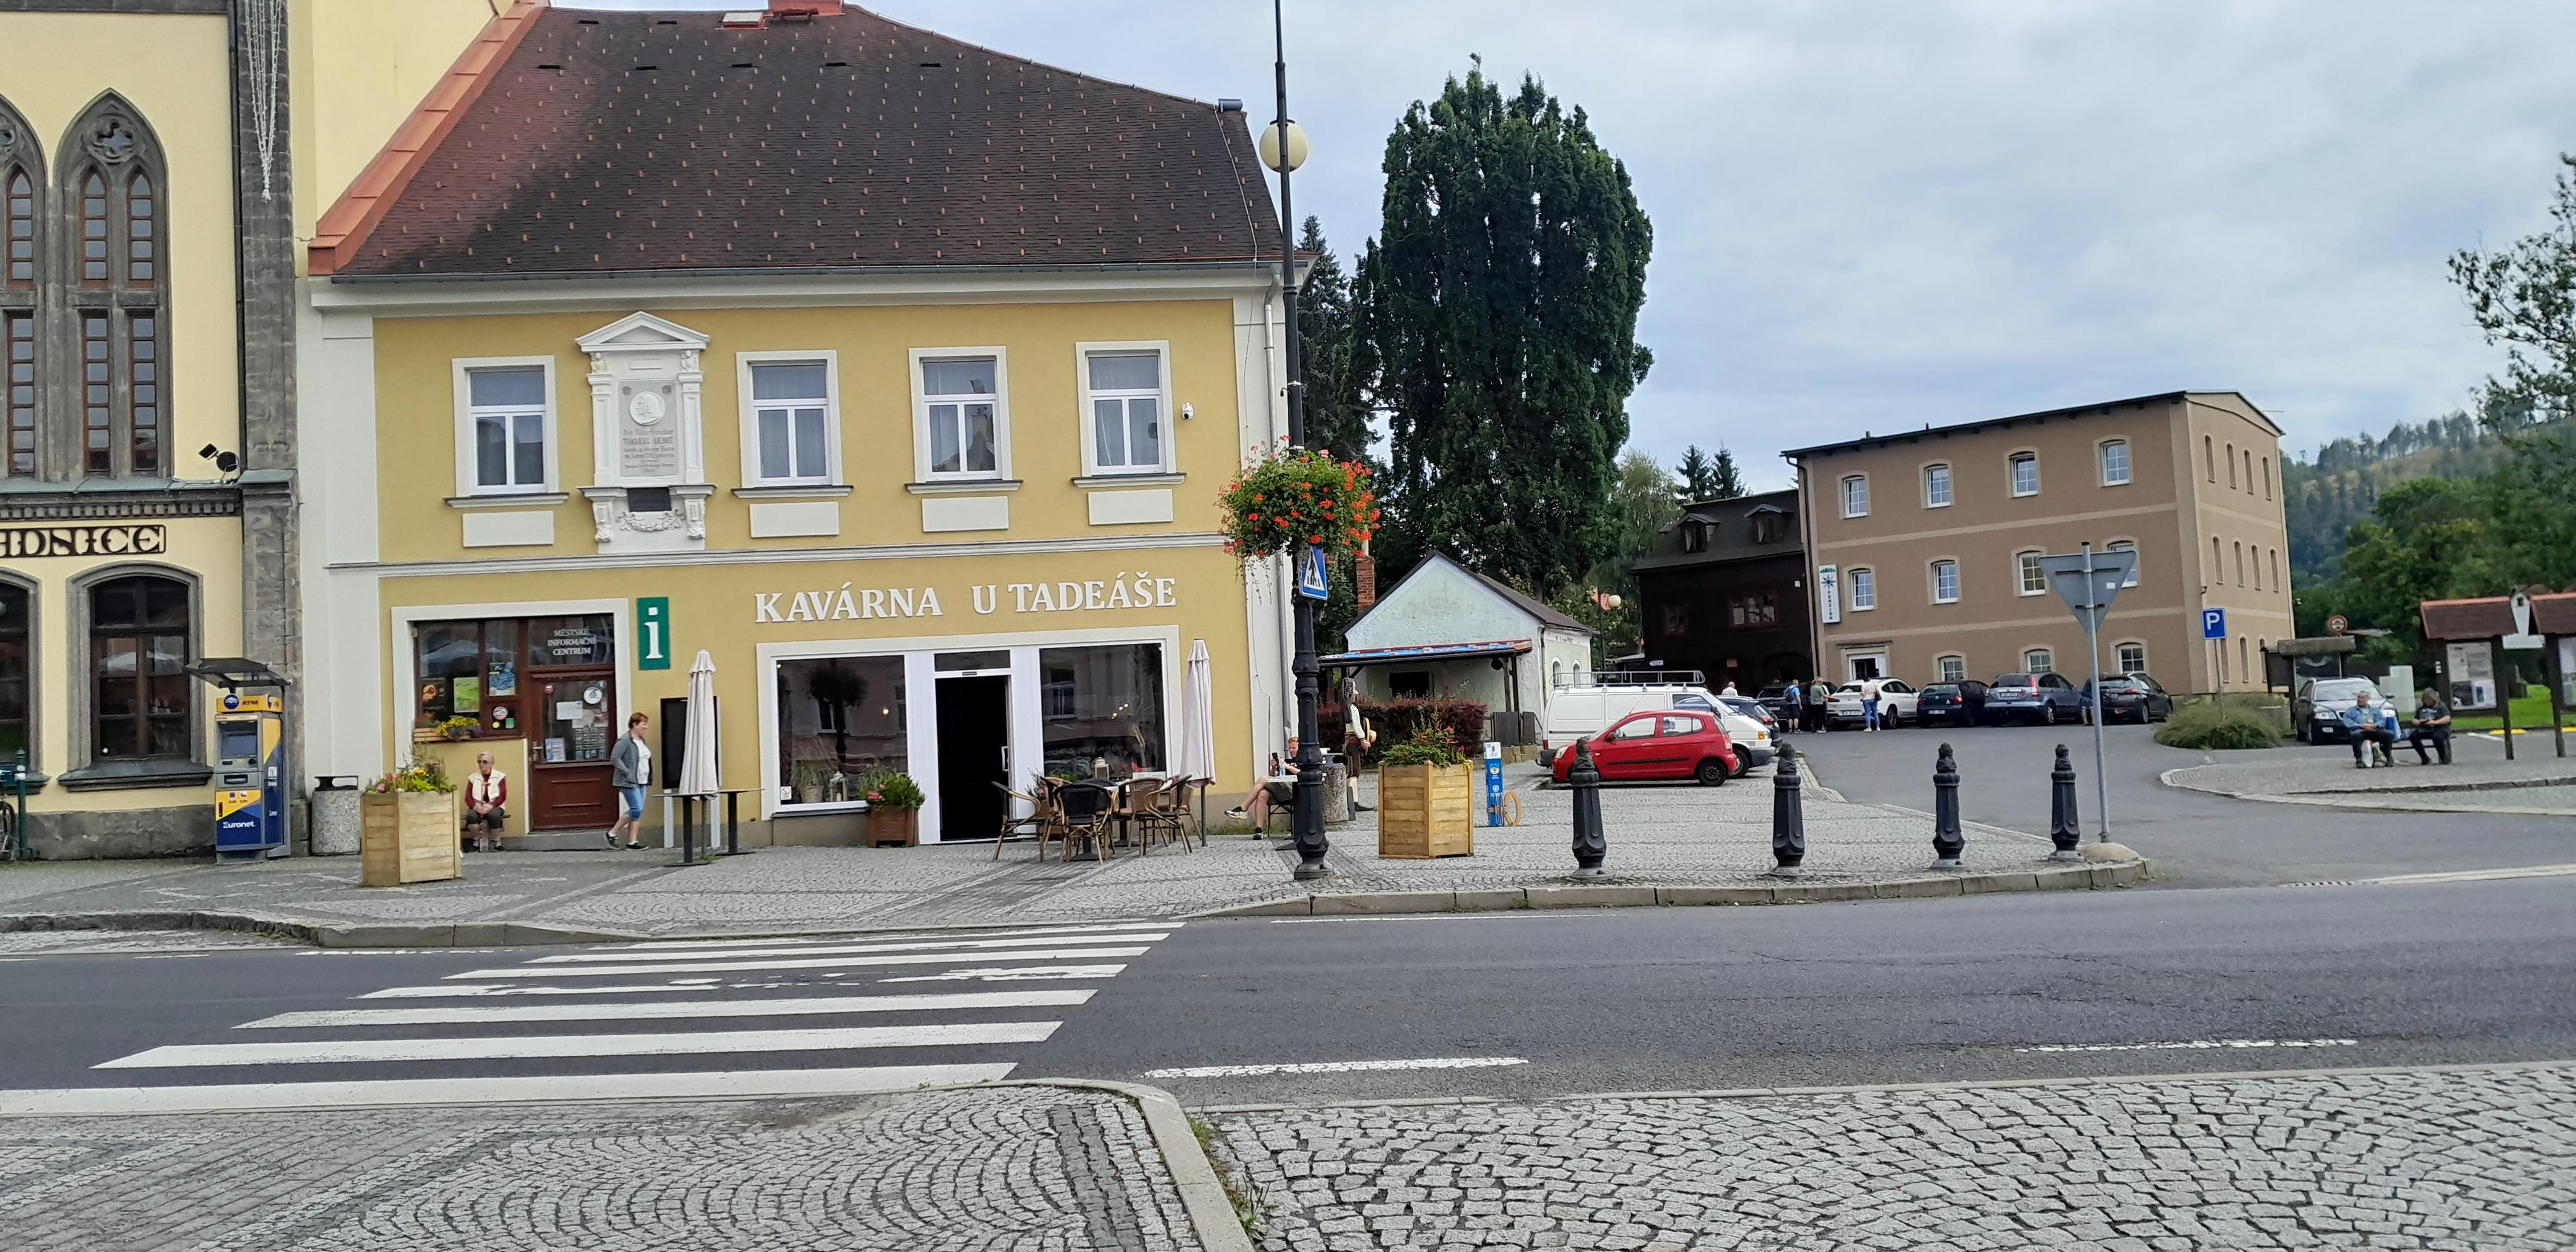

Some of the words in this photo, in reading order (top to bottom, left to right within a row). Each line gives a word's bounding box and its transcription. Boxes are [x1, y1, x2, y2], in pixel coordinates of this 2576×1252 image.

[754, 581, 943, 623] KAVÁRNA
[970, 585, 997, 614] U
[1007, 571, 1177, 613] TADEÁŠE
[2206, 612, 2220, 631] P
[553, 626, 589, 637] MĚSTSKÉ
[547, 634, 597, 647] INFORMAČNÍ
[552, 646, 591, 656] CENTRUM
[222, 820, 255, 829] Euronet
